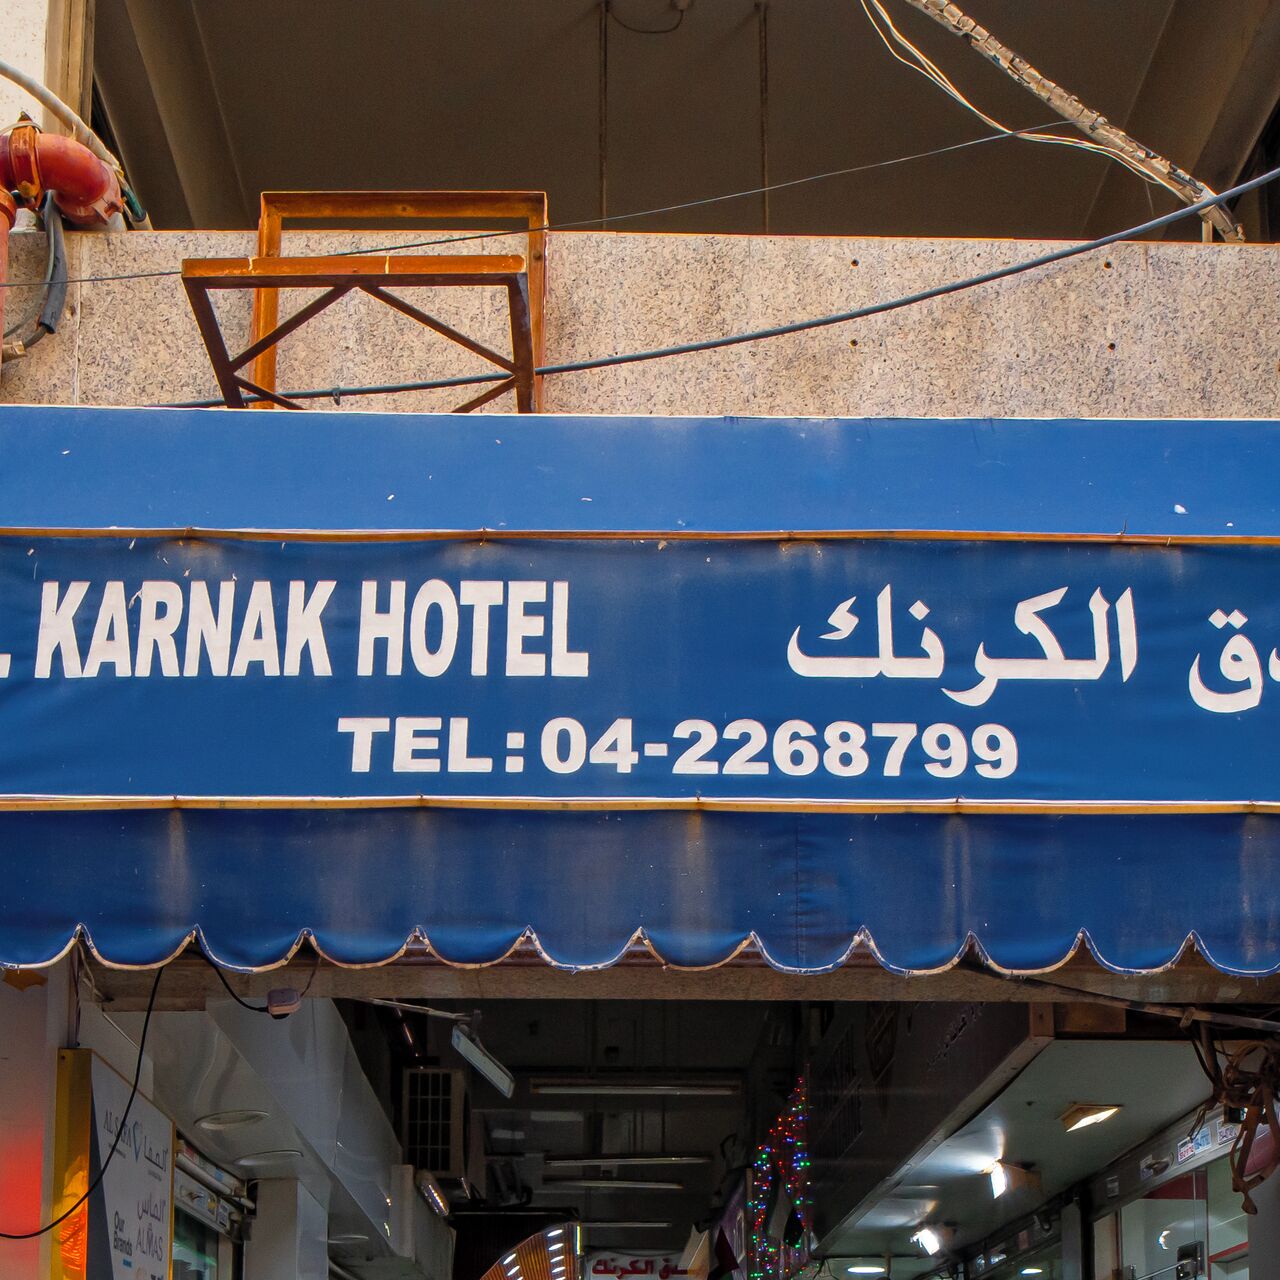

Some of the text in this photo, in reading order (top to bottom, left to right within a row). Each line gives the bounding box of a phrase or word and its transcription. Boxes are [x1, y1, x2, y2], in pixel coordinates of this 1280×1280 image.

[34, 580, 338, 679] KARNAK
[356, 578, 590, 678] HOTEL
[786, 583, 1138, 708] الكرنك
